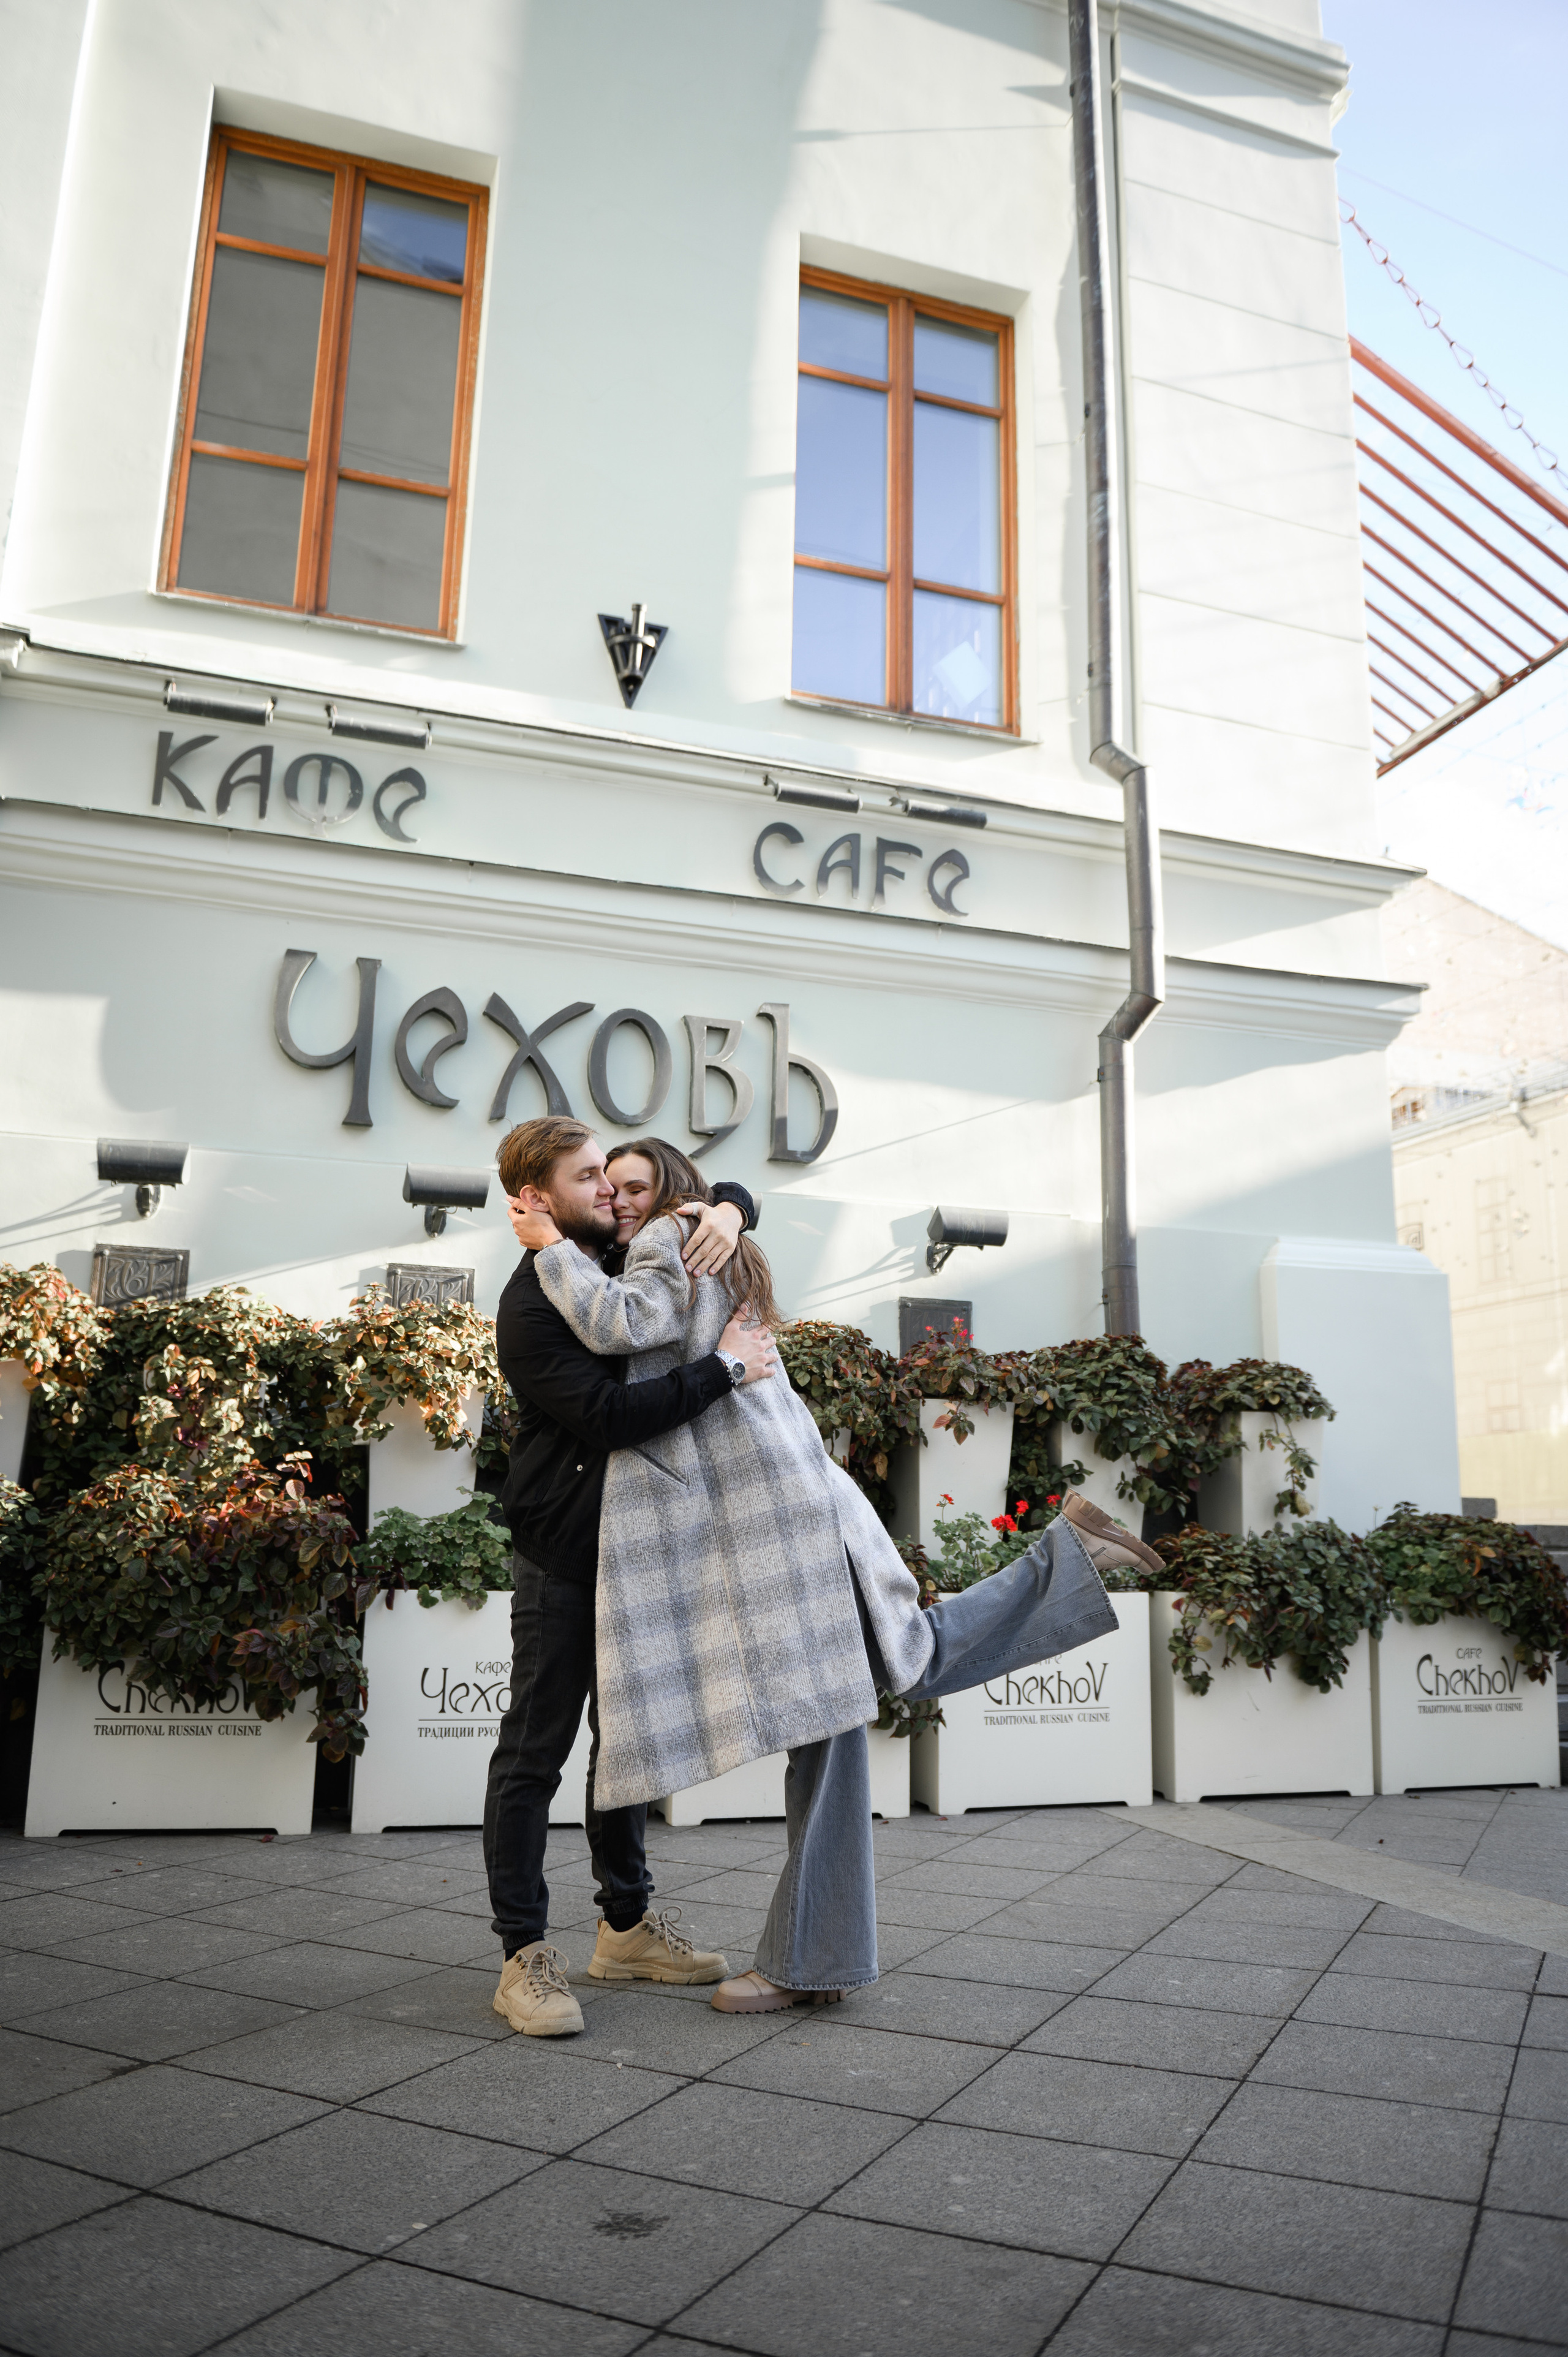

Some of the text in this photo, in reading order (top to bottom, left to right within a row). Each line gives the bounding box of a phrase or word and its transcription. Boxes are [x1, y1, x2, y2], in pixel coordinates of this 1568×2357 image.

[1418, 1703, 1523, 1714] TRADITIONAL RUSSIAN CUISINE
[984, 1713, 1110, 1725] TRADITIONAL RUSSIAN CUISINE
[94, 1725, 262, 1736] TRADITIONAL RUSSIAN CUISINE
[417, 1727, 475, 1739] ТРАДИЦИИ
